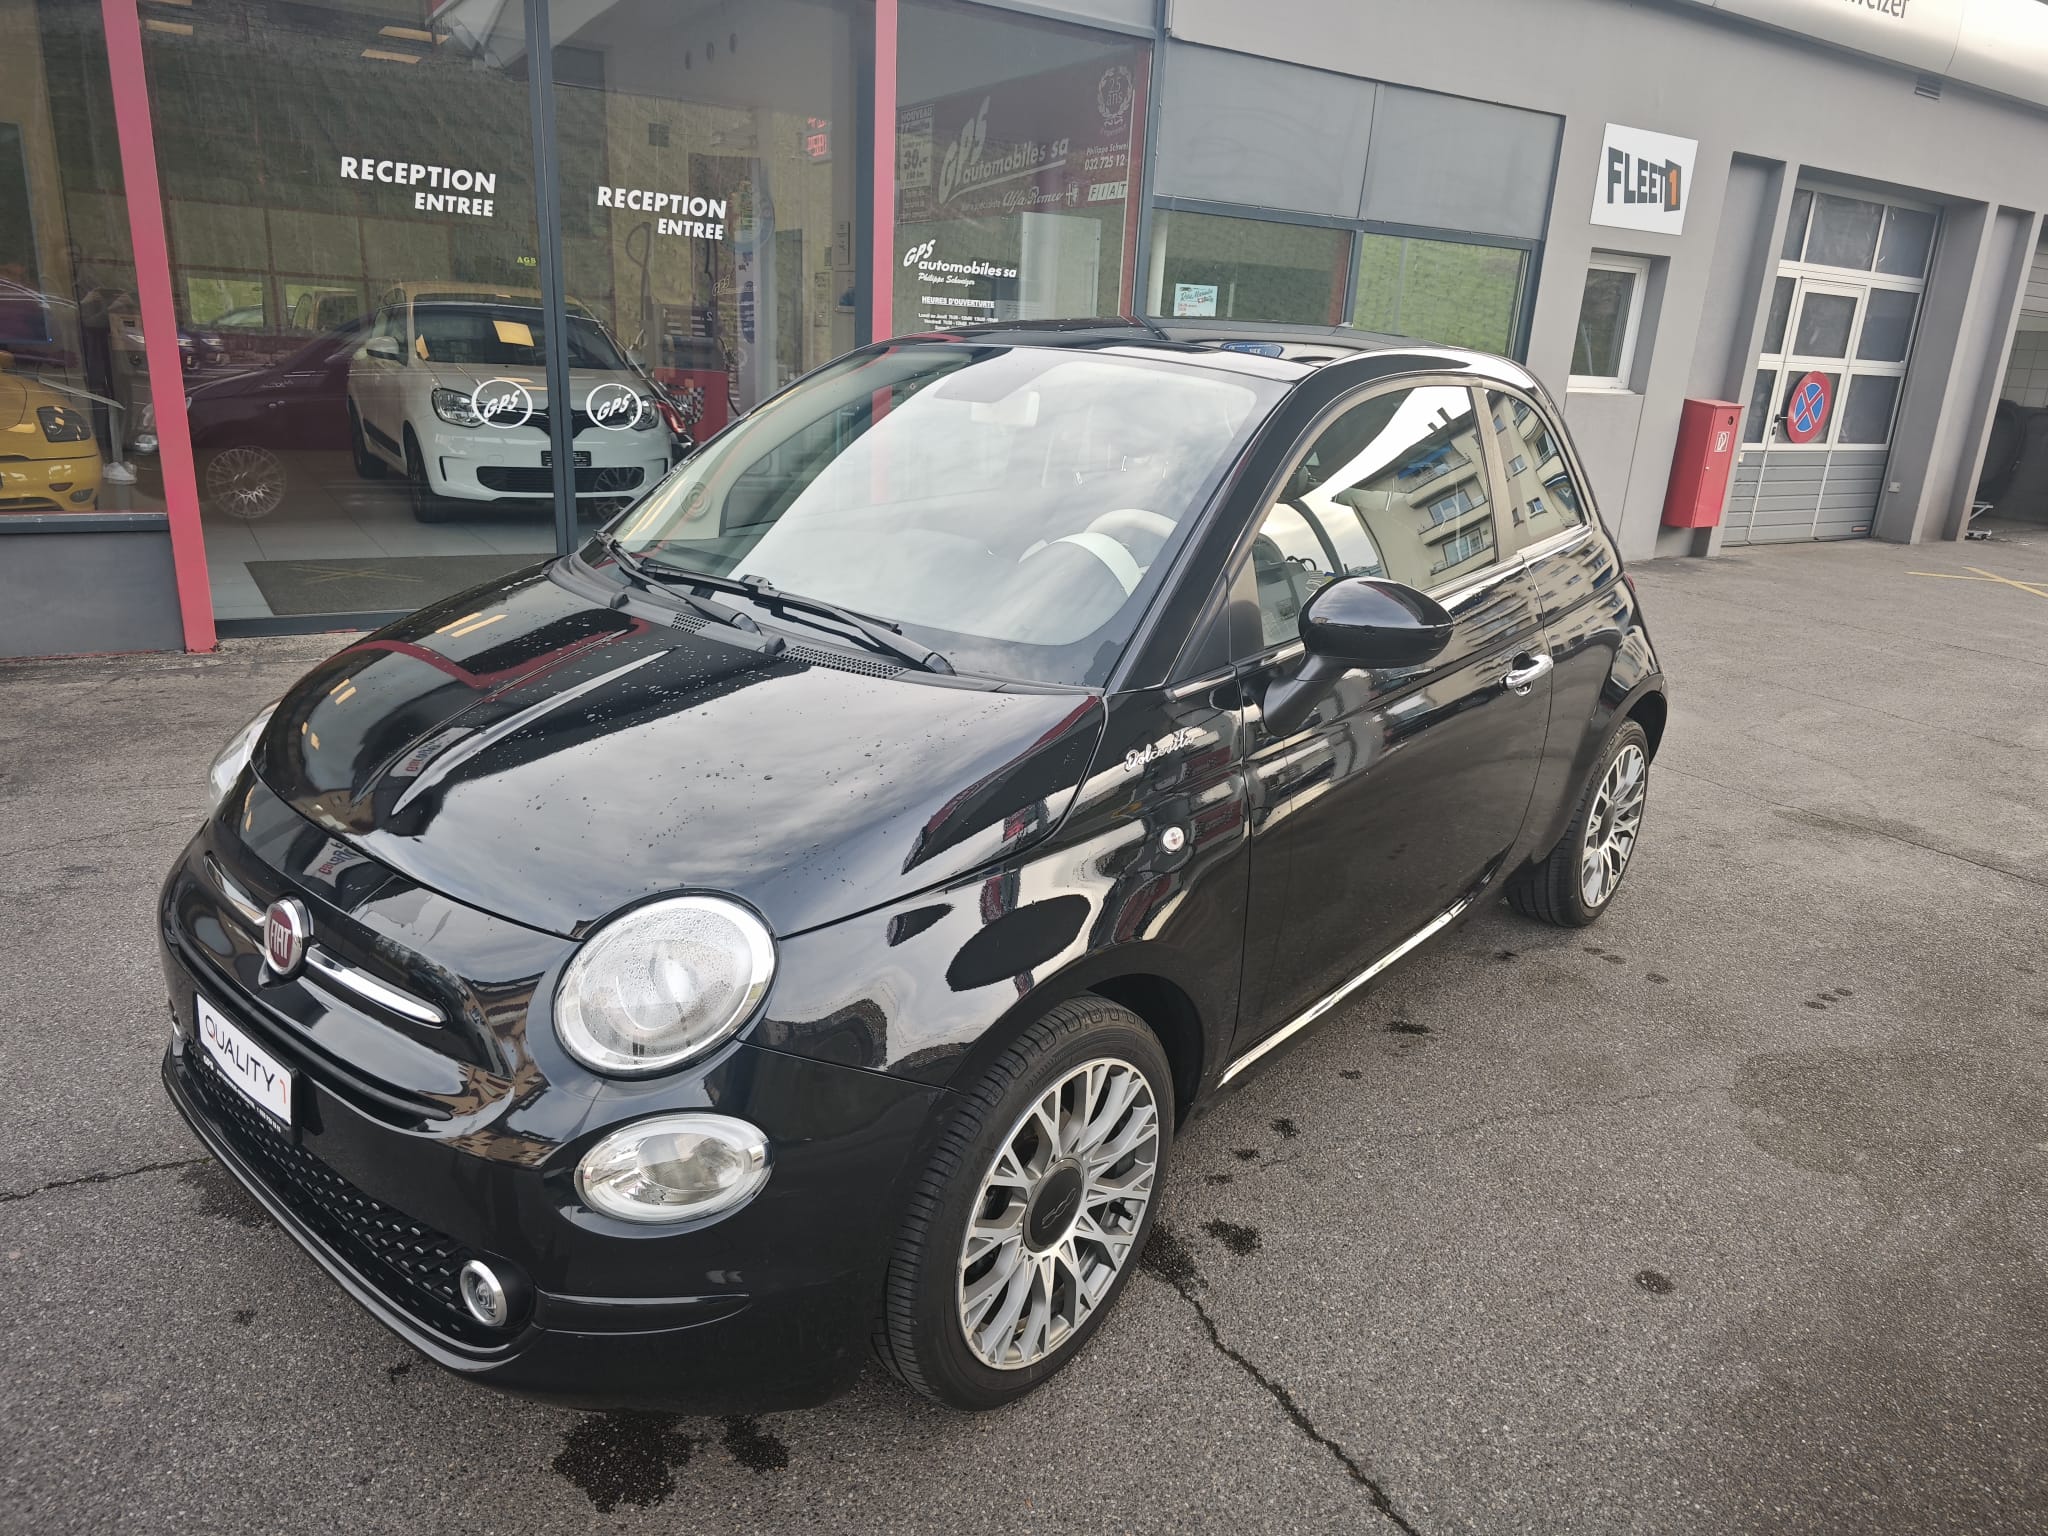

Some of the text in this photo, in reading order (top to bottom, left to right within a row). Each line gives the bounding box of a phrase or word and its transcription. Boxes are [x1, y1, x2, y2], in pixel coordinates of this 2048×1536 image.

[962, 140, 1046, 182] automobiles
[1051, 137, 1070, 158] sa
[340, 156, 496, 194] RECEPTION
[414, 192, 494, 217] ENTREE
[597, 186, 727, 219] RECEPTION
[1088, 181, 1127, 200] FIAT
[657, 218, 724, 240] ENTREE
[903, 239, 936, 267] GPS
[918, 260, 1017, 278] automobiles sa
[483, 390, 521, 418] GPS
[597, 393, 632, 421] GPS
[269, 918, 292, 960] FIAT
[205, 1014, 275, 1093] QUALITY
